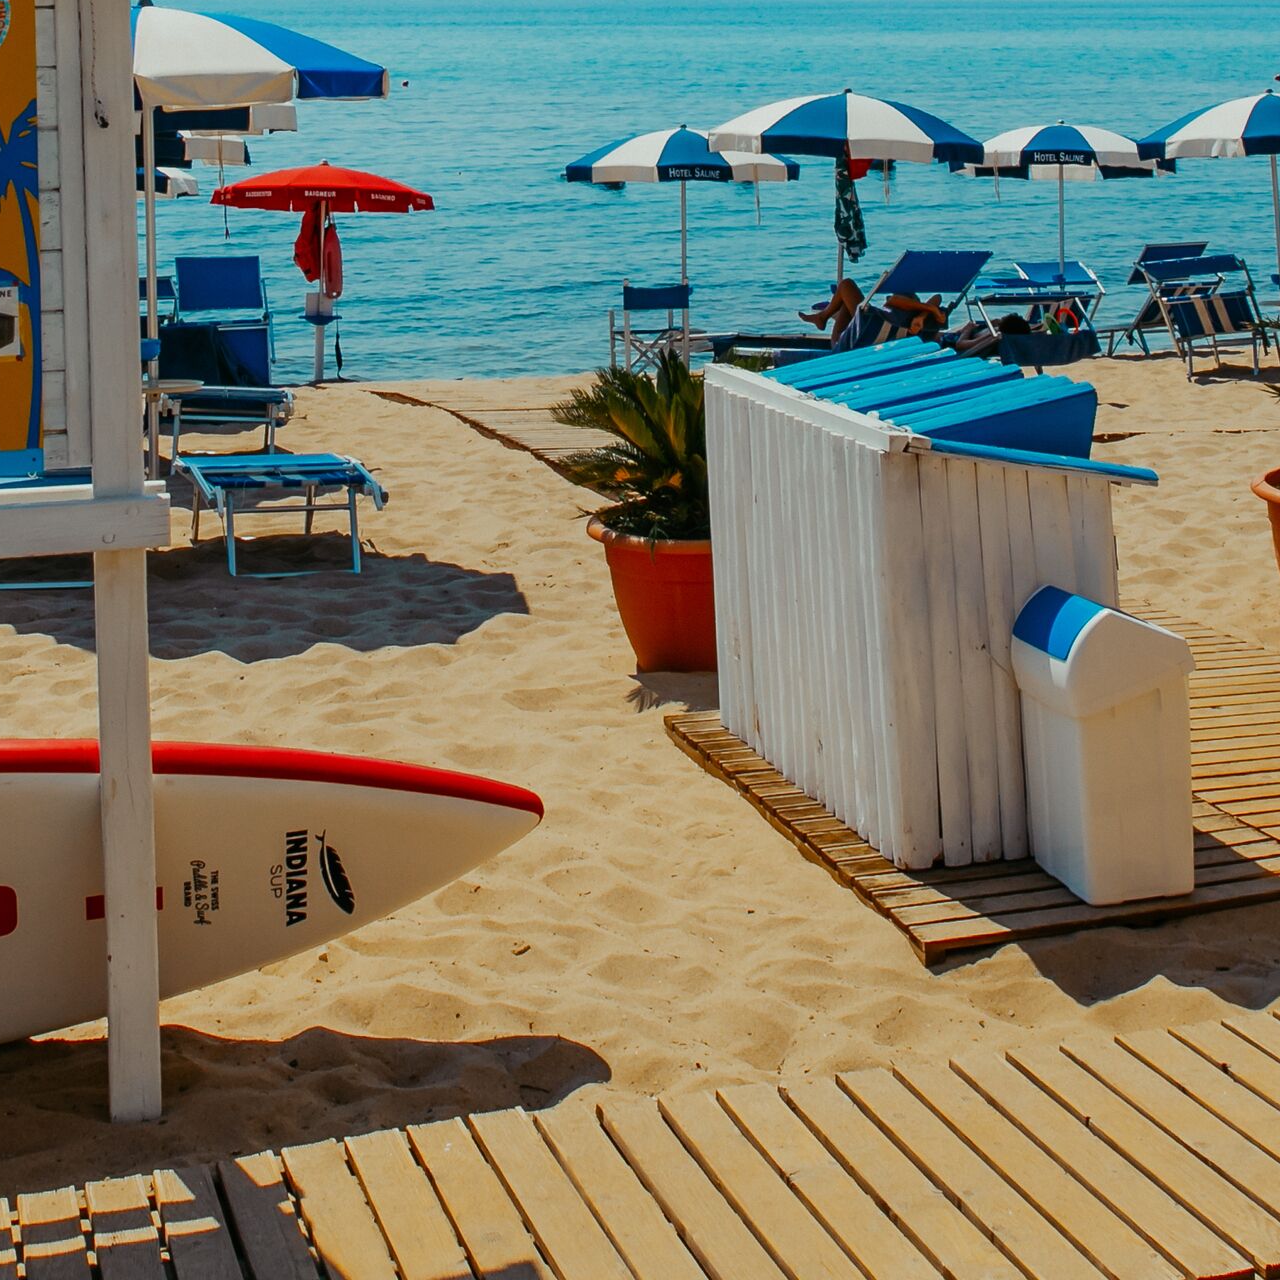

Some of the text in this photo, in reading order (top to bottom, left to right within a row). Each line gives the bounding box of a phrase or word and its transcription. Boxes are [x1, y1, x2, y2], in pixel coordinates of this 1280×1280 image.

[668, 167, 721, 179] HOTEL SALINE
[1033, 151, 1085, 163] HOTEL SALINE
[190, 860, 209, 893] Paddle
[210, 870, 220, 911] THE SWISS
[270, 864, 283, 899] SUP
[286, 829, 309, 927] INDIANA
[183, 881, 192, 907] BRAND
